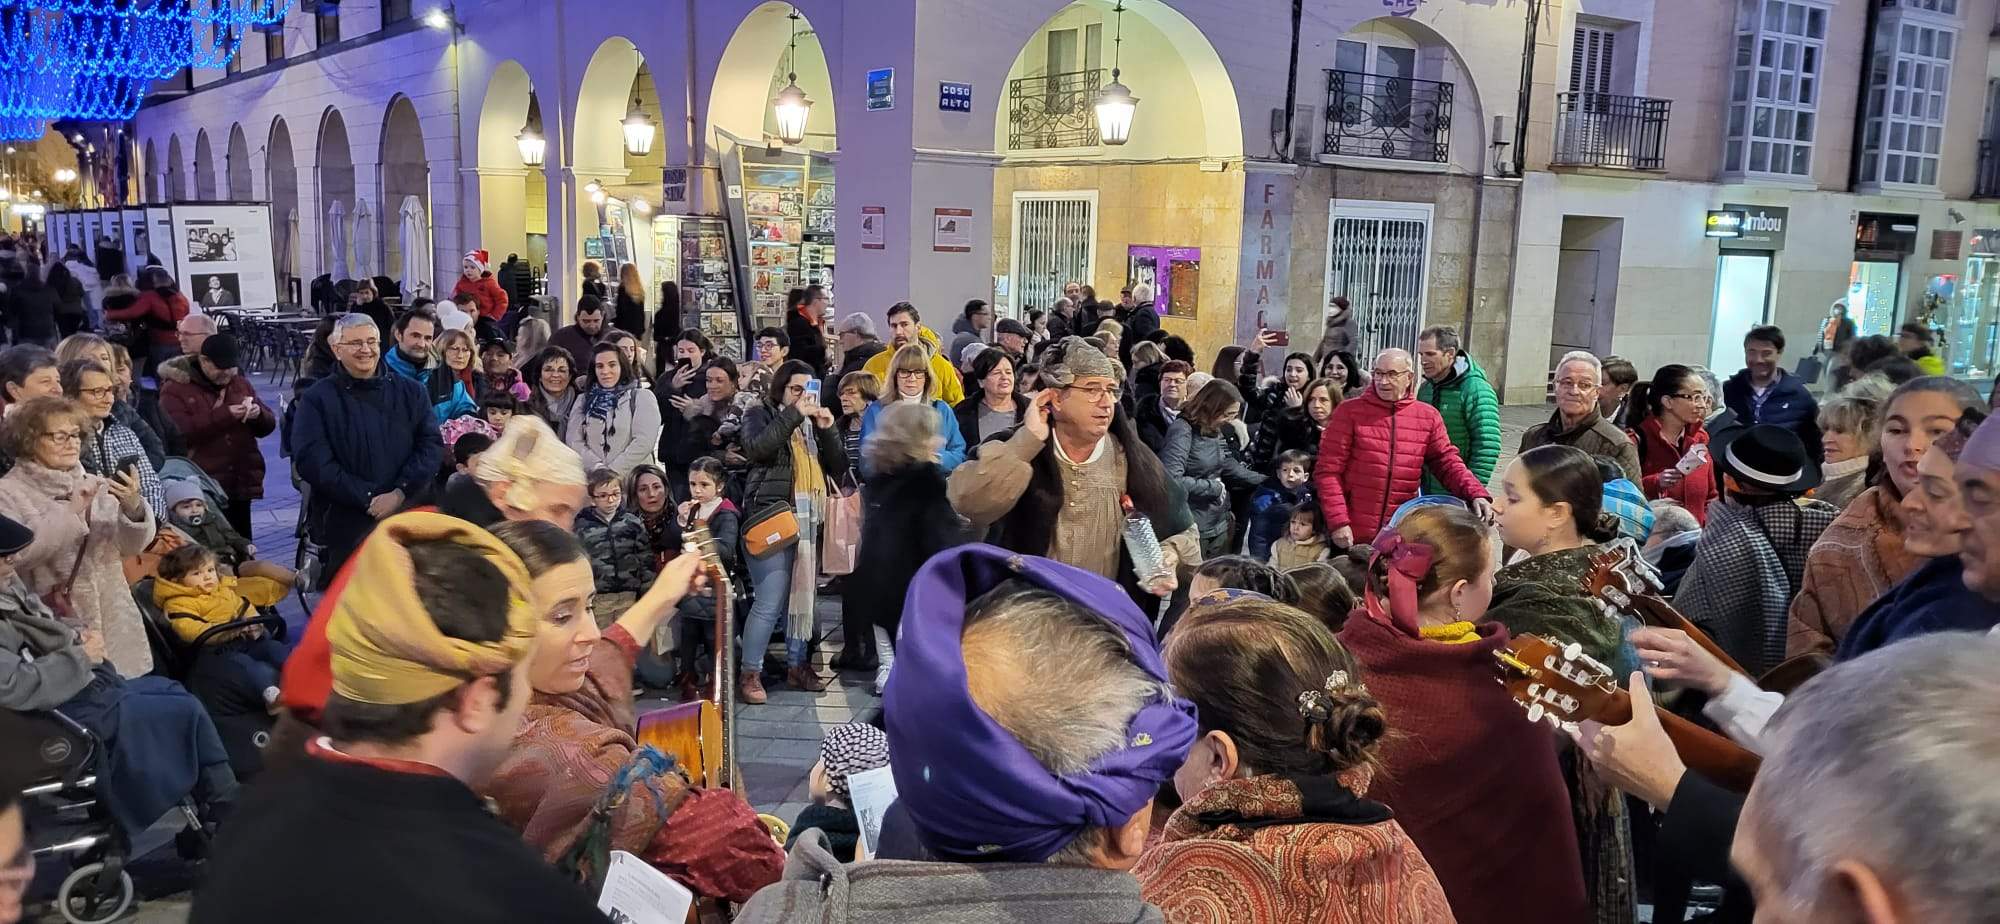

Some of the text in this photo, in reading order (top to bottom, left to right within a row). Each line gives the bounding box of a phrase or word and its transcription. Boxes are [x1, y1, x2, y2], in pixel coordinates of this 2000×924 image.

[942, 86, 970, 96] COSO
[942, 98, 969, 109] ALTO
[1744, 211, 1782, 232] mbou
